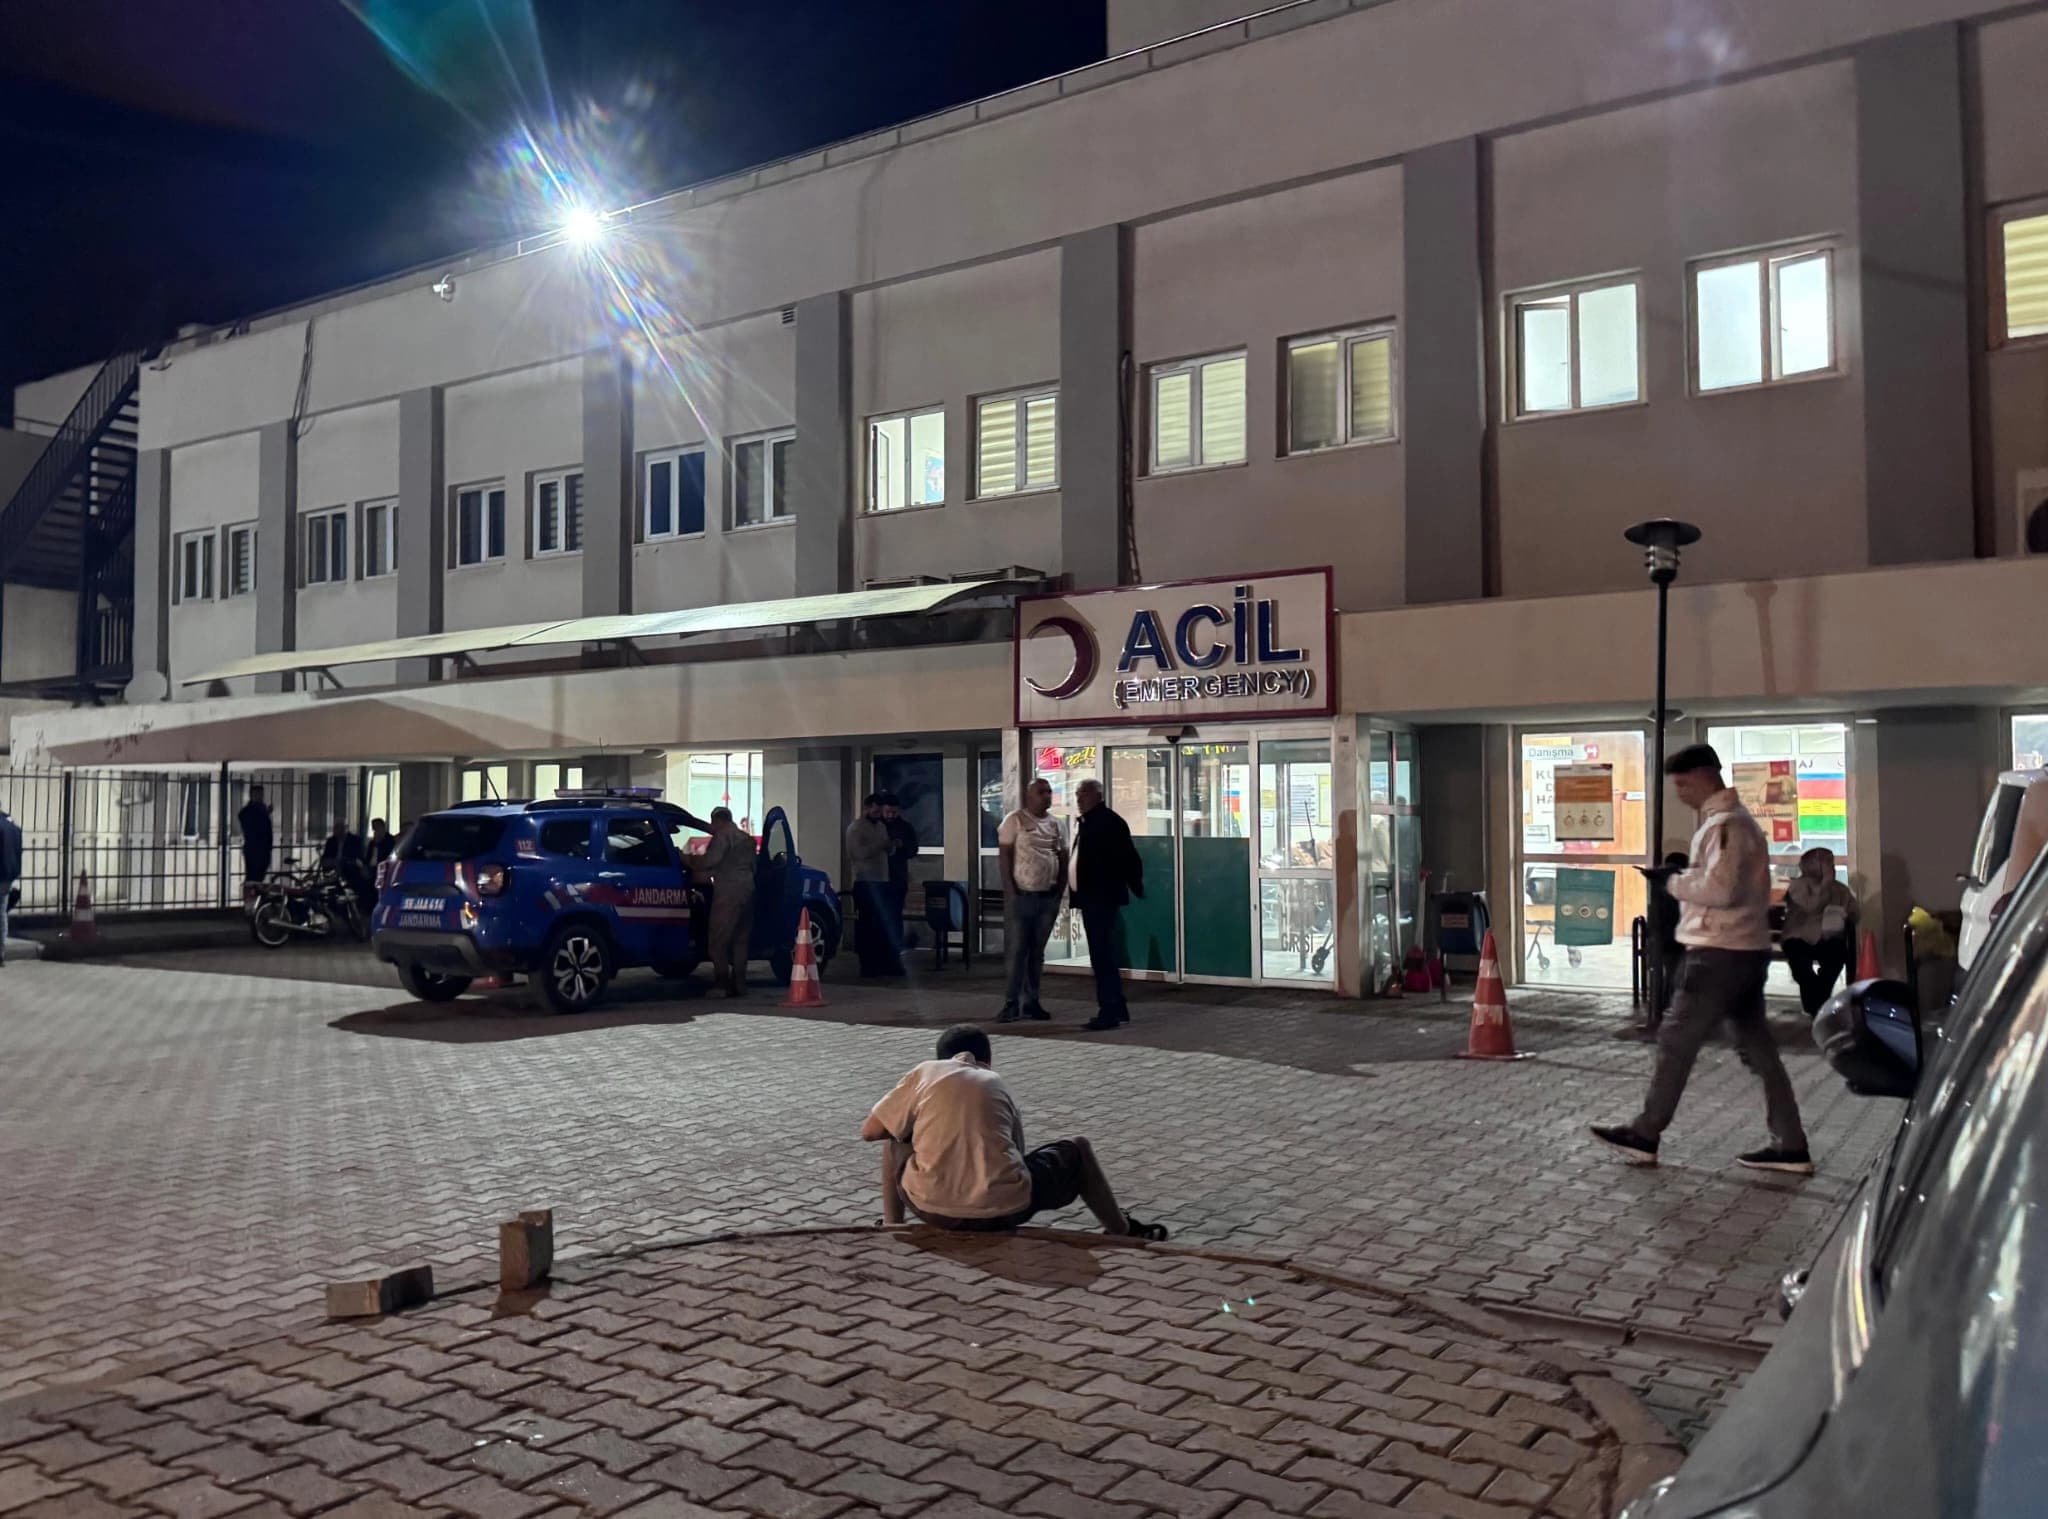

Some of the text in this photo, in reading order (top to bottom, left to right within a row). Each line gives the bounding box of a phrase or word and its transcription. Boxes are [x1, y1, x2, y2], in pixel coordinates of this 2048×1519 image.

[1114, 584, 1306, 673] ACİL
[1112, 668, 1312, 709] (EMERGENCY)
[1528, 747, 1574, 759] Danışma
[517, 839, 533, 851] 112
[631, 887, 688, 905] JANDARMA
[398, 912, 442, 928] JANDARMA
